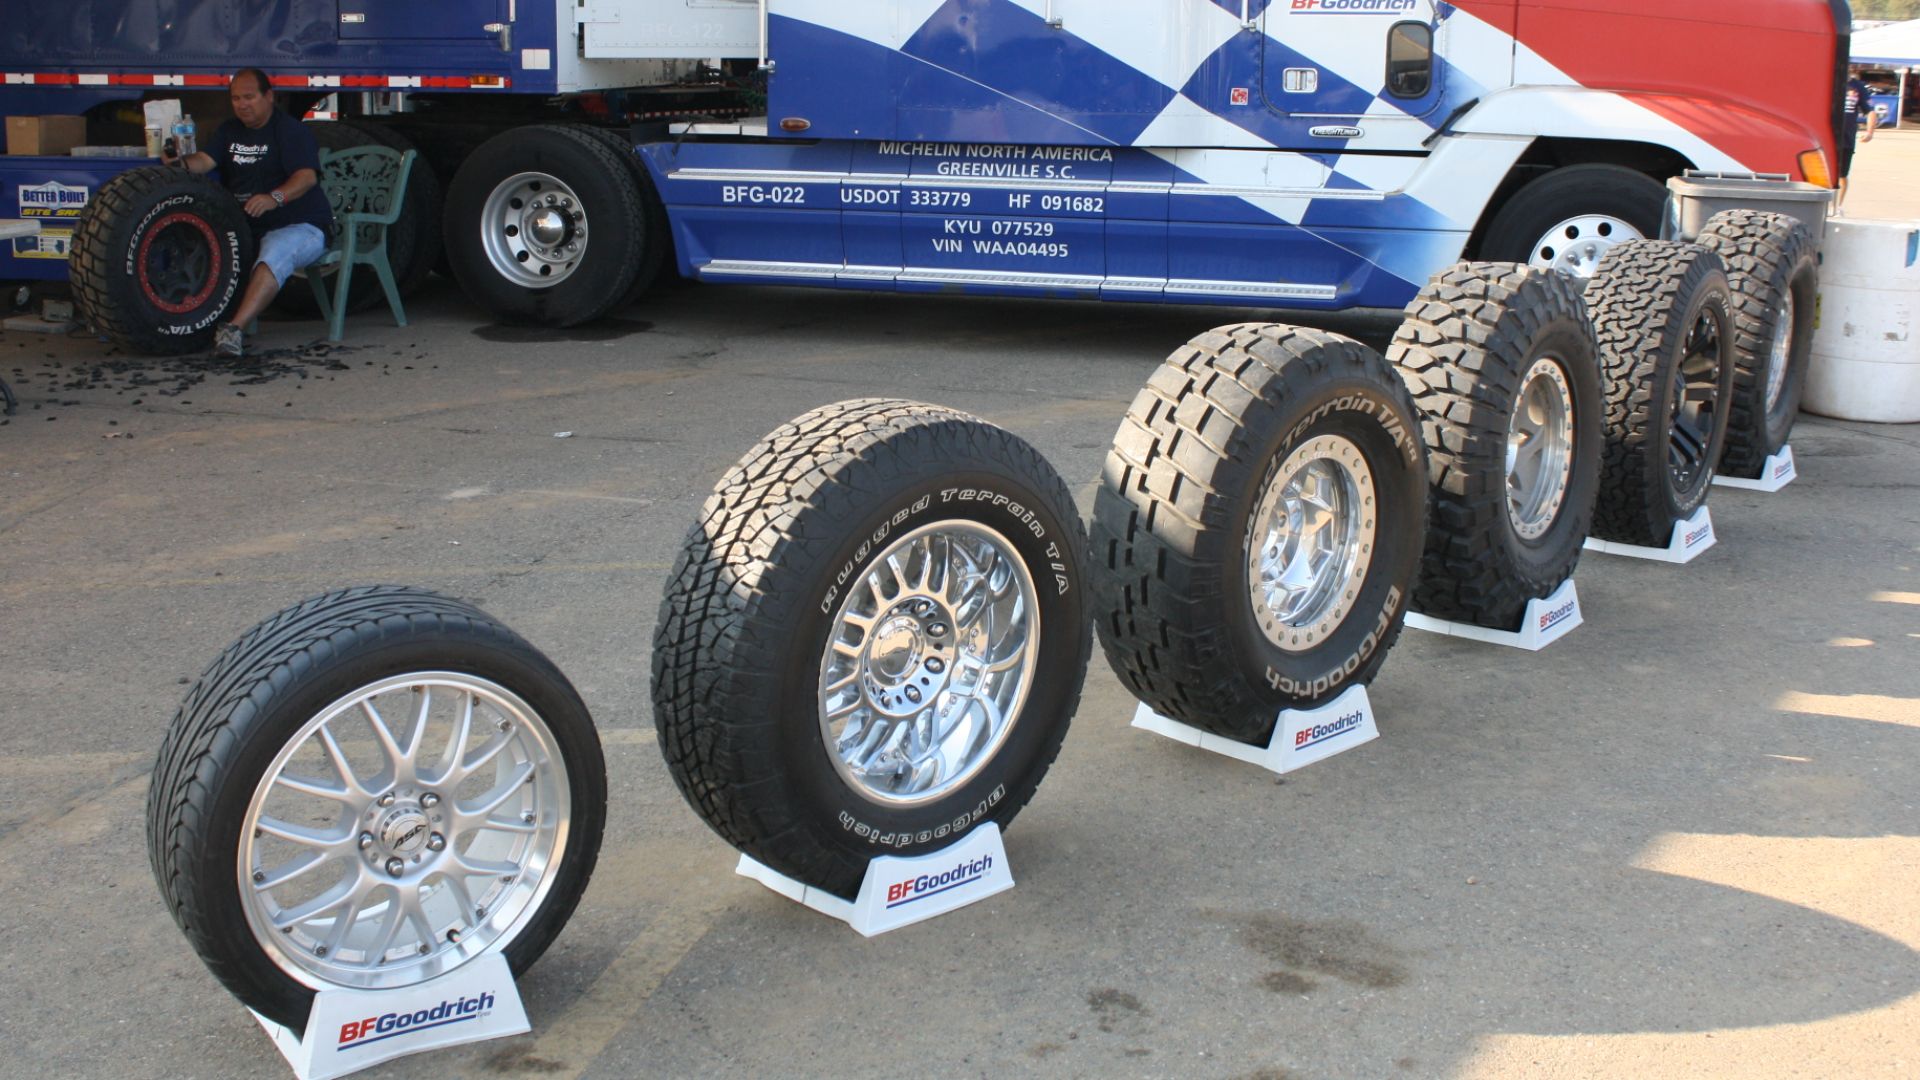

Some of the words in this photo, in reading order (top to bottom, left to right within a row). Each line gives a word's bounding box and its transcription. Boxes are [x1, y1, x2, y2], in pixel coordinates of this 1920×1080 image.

[879, 141, 962, 157] MICHELIN
[966, 144, 1026, 160] NORTH
[1031, 146, 1113, 162] AMERICA
[937, 161, 1040, 179] GREENVILLE
[1045, 165, 1077, 180] S.C.
[23, 189, 57, 203] BETTER
[59, 189, 86, 203] BUILT
[56, 209, 81, 217] SAF
[722, 186, 805, 204] BFG-022
[841, 188, 901, 205] USDOT
[910, 191, 971, 207] 333779
[1008, 193, 1031, 209] HF
[1041, 196, 1104, 213] 091682
[126, 194, 195, 275] BFGoodrich
[944, 219, 982, 235] KYU
[991, 221, 1054, 237] 077529
[932, 238, 963, 253] VIN
[973, 241, 1069, 258] WAA04495
[194, 231, 241, 330] Mud-Terrain
[169, 324, 194, 336] T/A
[1376, 404, 1407, 448] T/A
[820, 494, 930, 614] Rugged
[940, 487, 1045, 539] Terrain
[1045, 542, 1069, 595] T/A
[1265, 584, 1401, 700] BFGoodrich
[1295, 709, 1363, 746] BFGoodrich
[838, 783, 1006, 848] BFGoodrich
[887, 853, 993, 903] BFGoodrich
[338, 991, 495, 1044] BFGoodrich
